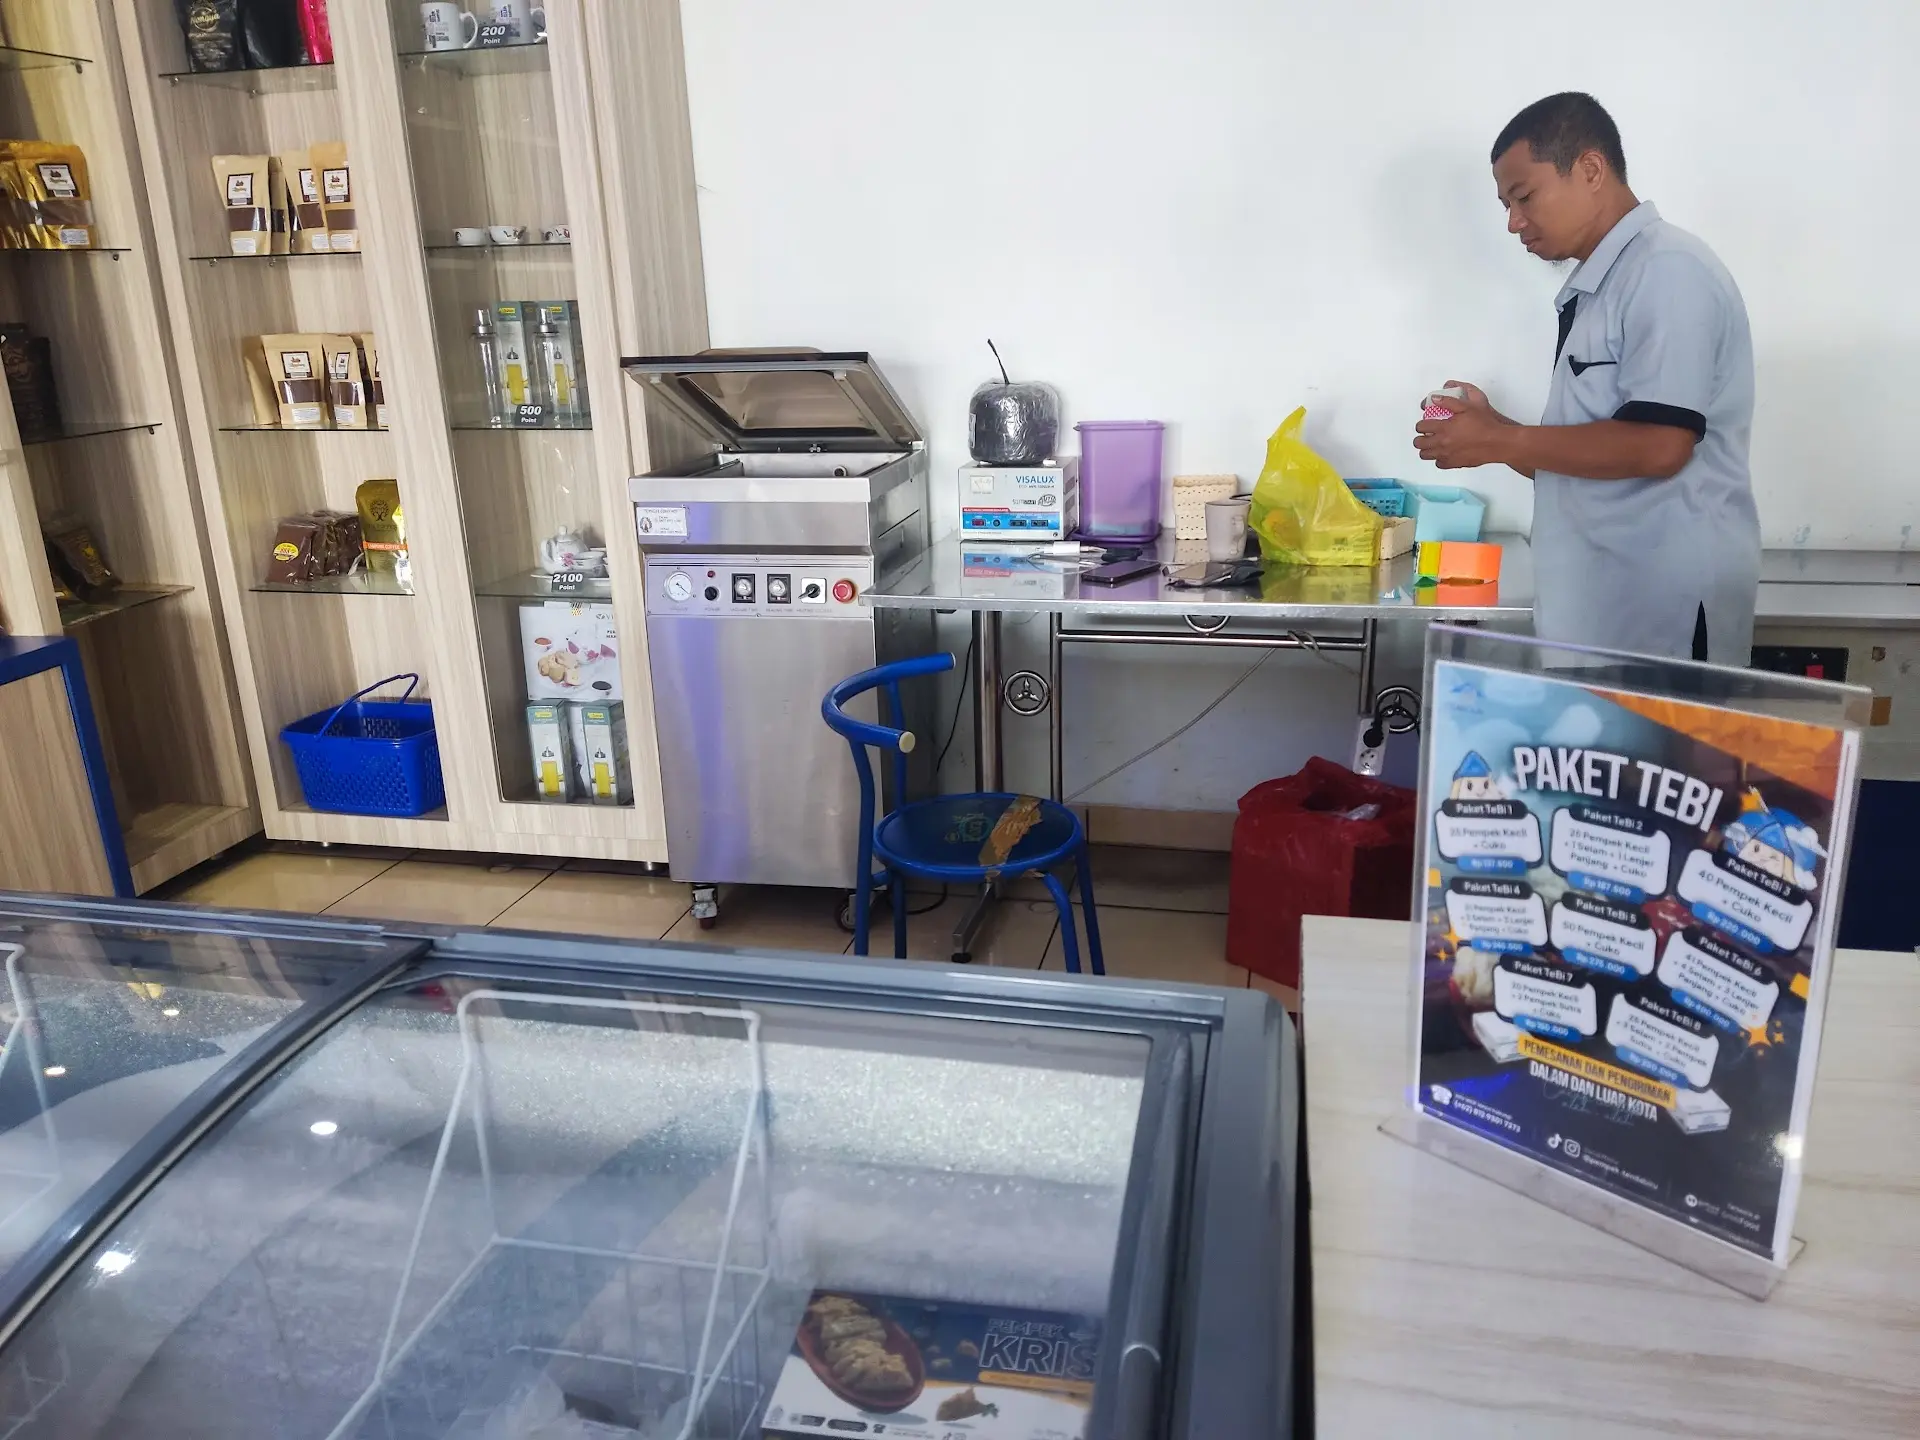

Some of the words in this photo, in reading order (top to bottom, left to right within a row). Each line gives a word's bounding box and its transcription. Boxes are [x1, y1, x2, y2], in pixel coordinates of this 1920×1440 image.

[481, 25, 505, 37] 200
[519, 405, 542, 416] 500
[1015, 475, 1055, 484] VISALUX
[552, 573, 583, 584] 2100
[1513, 746, 1629, 800] PAKET
[1636, 759, 1724, 833] TEBI
[1456, 803, 1484, 815] Paket
[1486, 804, 1506, 816] TeBi
[1507, 804, 1513, 815] 1
[1583, 808, 1612, 823] Paket
[1614, 813, 1635, 827] TeBi
[1635, 820, 1644, 831] 2
[1463, 828, 1501, 839] Pempek
[1503, 828, 1528, 838] Kecil
[1583, 831, 1623, 848] Pempek
[1625, 838, 1651, 854] Kecil
[1481, 841, 1507, 850] Cuko
[1577, 843, 1608, 857] Selam
[1623, 853, 1654, 870] Lenjer
[1570, 852, 1609, 870] Panjang
[1621, 864, 1648, 879] Cuko
[1463, 881, 1491, 893] Paket
[1492, 883, 1513, 894] TeBi
[1513, 886, 1520, 895] 4
[1584, 877, 1595, 889] Rp
[1726, 858, 1759, 880] Paket
[1759, 874, 1783, 893] TeBi
[1783, 886, 1792, 897] 3
[1698, 870, 1714, 882] 40
[1716, 877, 1761, 909] Pempek
[1763, 900, 1794, 925] Kecil
[1474, 904, 1504, 915] Pempek
[1506, 905, 1527, 914] Kecil
[1576, 898, 1606, 914] Paket
[1607, 906, 1628, 921] TeBi
[1629, 913, 1638, 924] 5
[1707, 912, 1720, 925] Rp
[1731, 901, 1763, 923] Cuko
[1562, 920, 1574, 930] 50
[1577, 922, 1617, 943] Pempek
[1619, 936, 1645, 951] Kecil
[1594, 942, 1621, 956] Cuko
[1699, 936, 1730, 959] Paket
[1731, 951, 1754, 972] TeBi
[1754, 966, 1762, 977] 6
[1513, 960, 1543, 976] Paket
[1544, 967, 1566, 981] TeBi
[1566, 973, 1574, 983] 7
[1695, 959, 1732, 984] Pempek
[1734, 981, 1758, 998] Kecil
[1523, 983, 1558, 999] Pempek
[1558, 990, 1580, 1003] Kecil
[1678, 972, 1714, 998] Panjang
[1721, 997, 1747, 1016] Cuko
[1640, 996, 1670, 1017] Paket
[1670, 1008, 1694, 1028] TeBi
[1694, 1021, 1702, 1032] 8
[1641, 1016, 1677, 1042] Pempek
[1523, 1040, 1582, 1071] PEMESANAN
[1584, 1062, 1605, 1080] DAN
[1608, 1070, 1671, 1104] PENGIRIMAN
[1529, 1060, 1568, 1088] DALAM
[1570, 1074, 1595, 1098] DAN
[1595, 1085, 1626, 1111] LUAR
[1627, 1096, 1658, 1121] KOTA
